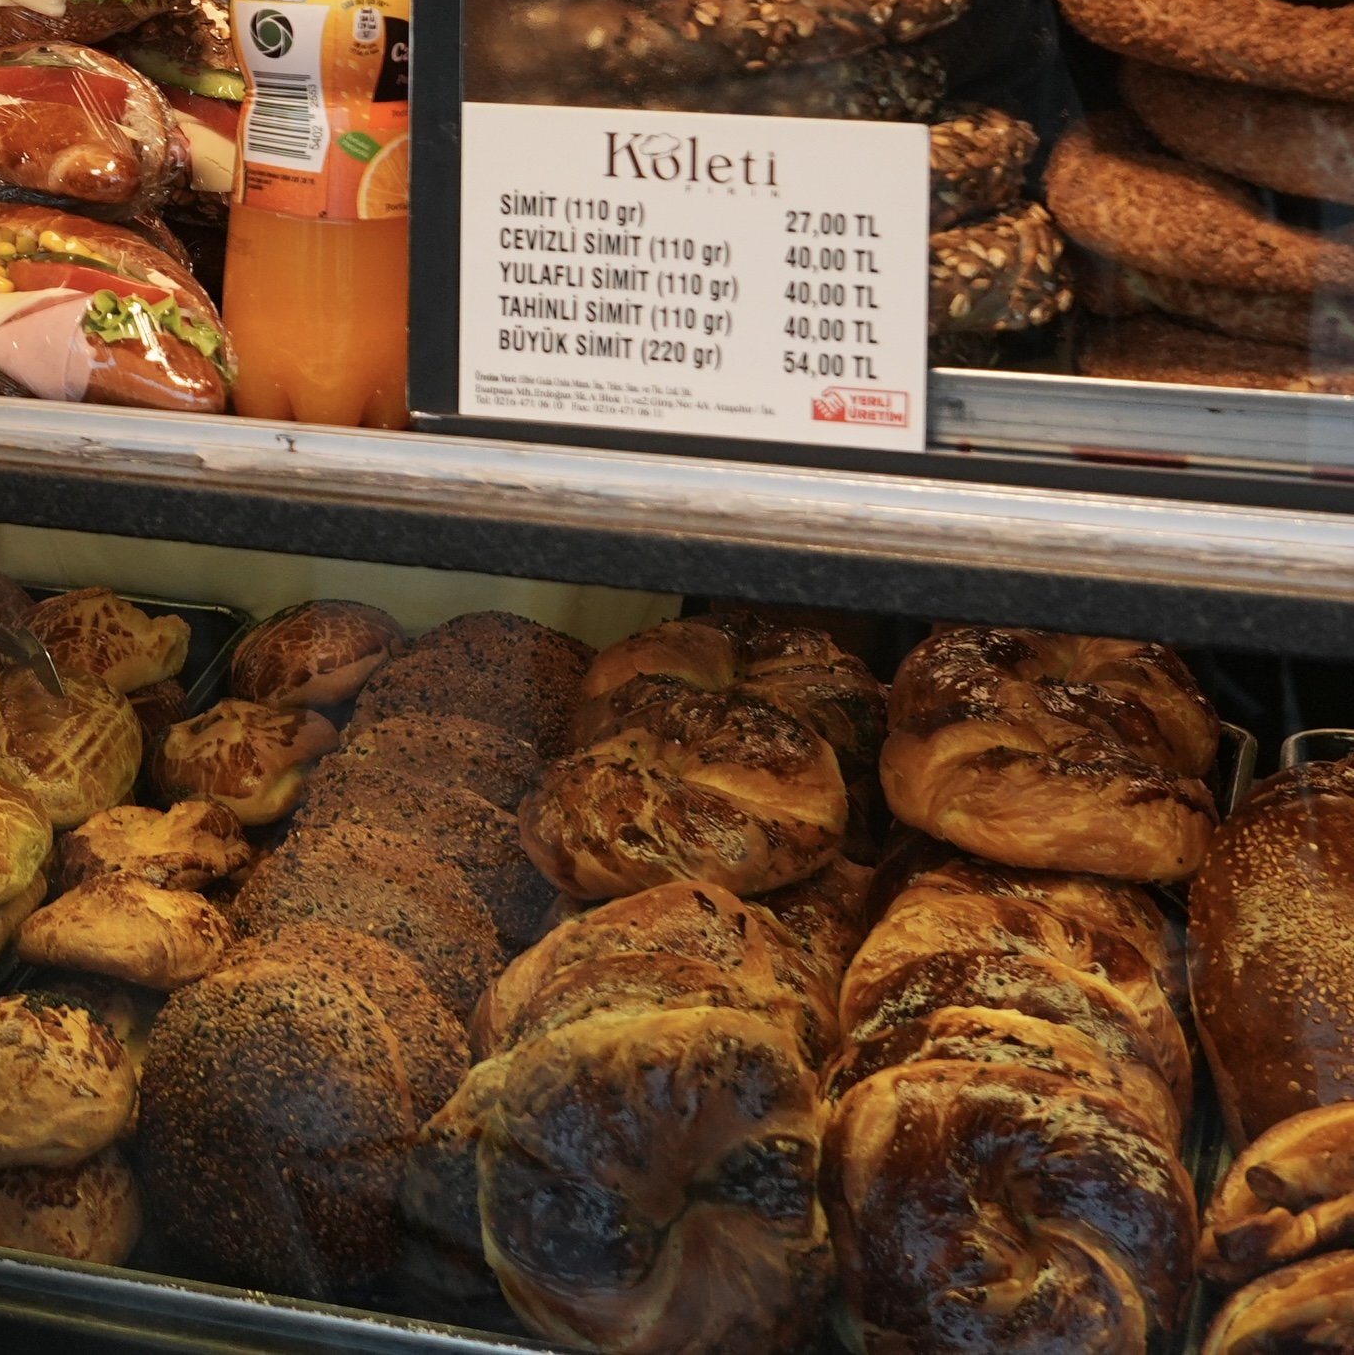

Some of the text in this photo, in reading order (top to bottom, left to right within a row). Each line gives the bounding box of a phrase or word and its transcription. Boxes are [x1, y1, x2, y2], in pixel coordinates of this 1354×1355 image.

[500, 189, 646, 228] SİMİT (110 gr)
[785, 210, 881, 238] 27,00 TL
[499, 224, 732, 266] CEVİZLİ SİMİT (110 gr)
[785, 246, 880, 273] 40,00 TL
[498, 260, 739, 301] YULAFLI SİMİT (110 gr)
[784, 281, 879, 309] 40,00 TL
[498, 292, 733, 336] TAHİNLİ SİMİT (110 gr)
[784, 316, 879, 344] 40,00 TL
[498, 325, 722, 371] BÜYÜK SİMİT (220 gr)
[783, 350, 879, 380] 54,00 TL
[848, 403, 905, 422] ÜRETİM
[849, 393, 891, 408] YERLİ
